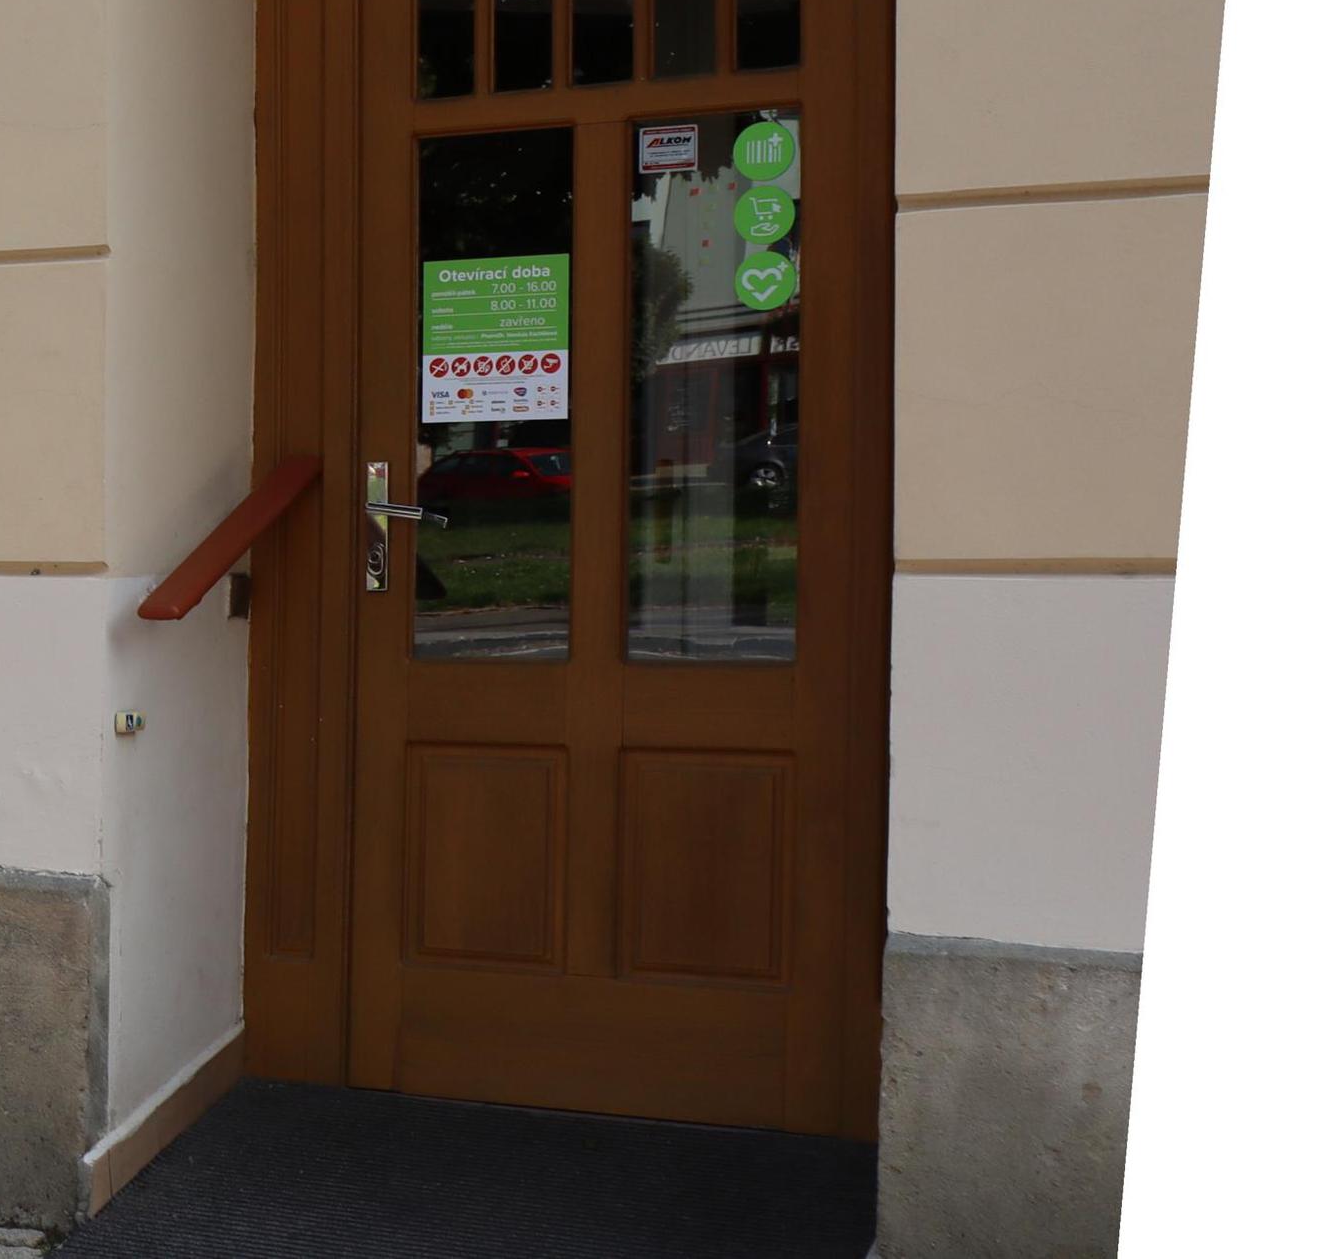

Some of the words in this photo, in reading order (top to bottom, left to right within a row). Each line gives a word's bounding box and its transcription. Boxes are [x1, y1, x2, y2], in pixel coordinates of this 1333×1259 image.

[439, 266, 507, 283] Otevírací
[512, 265, 551, 279] doba
[491, 282, 517, 294] 7.00
[527, 280, 557, 293] 16.00
[490, 299, 516, 311] 8.00
[527, 297, 557, 309] 11.00
[499, 315, 546, 327] zavřeno
